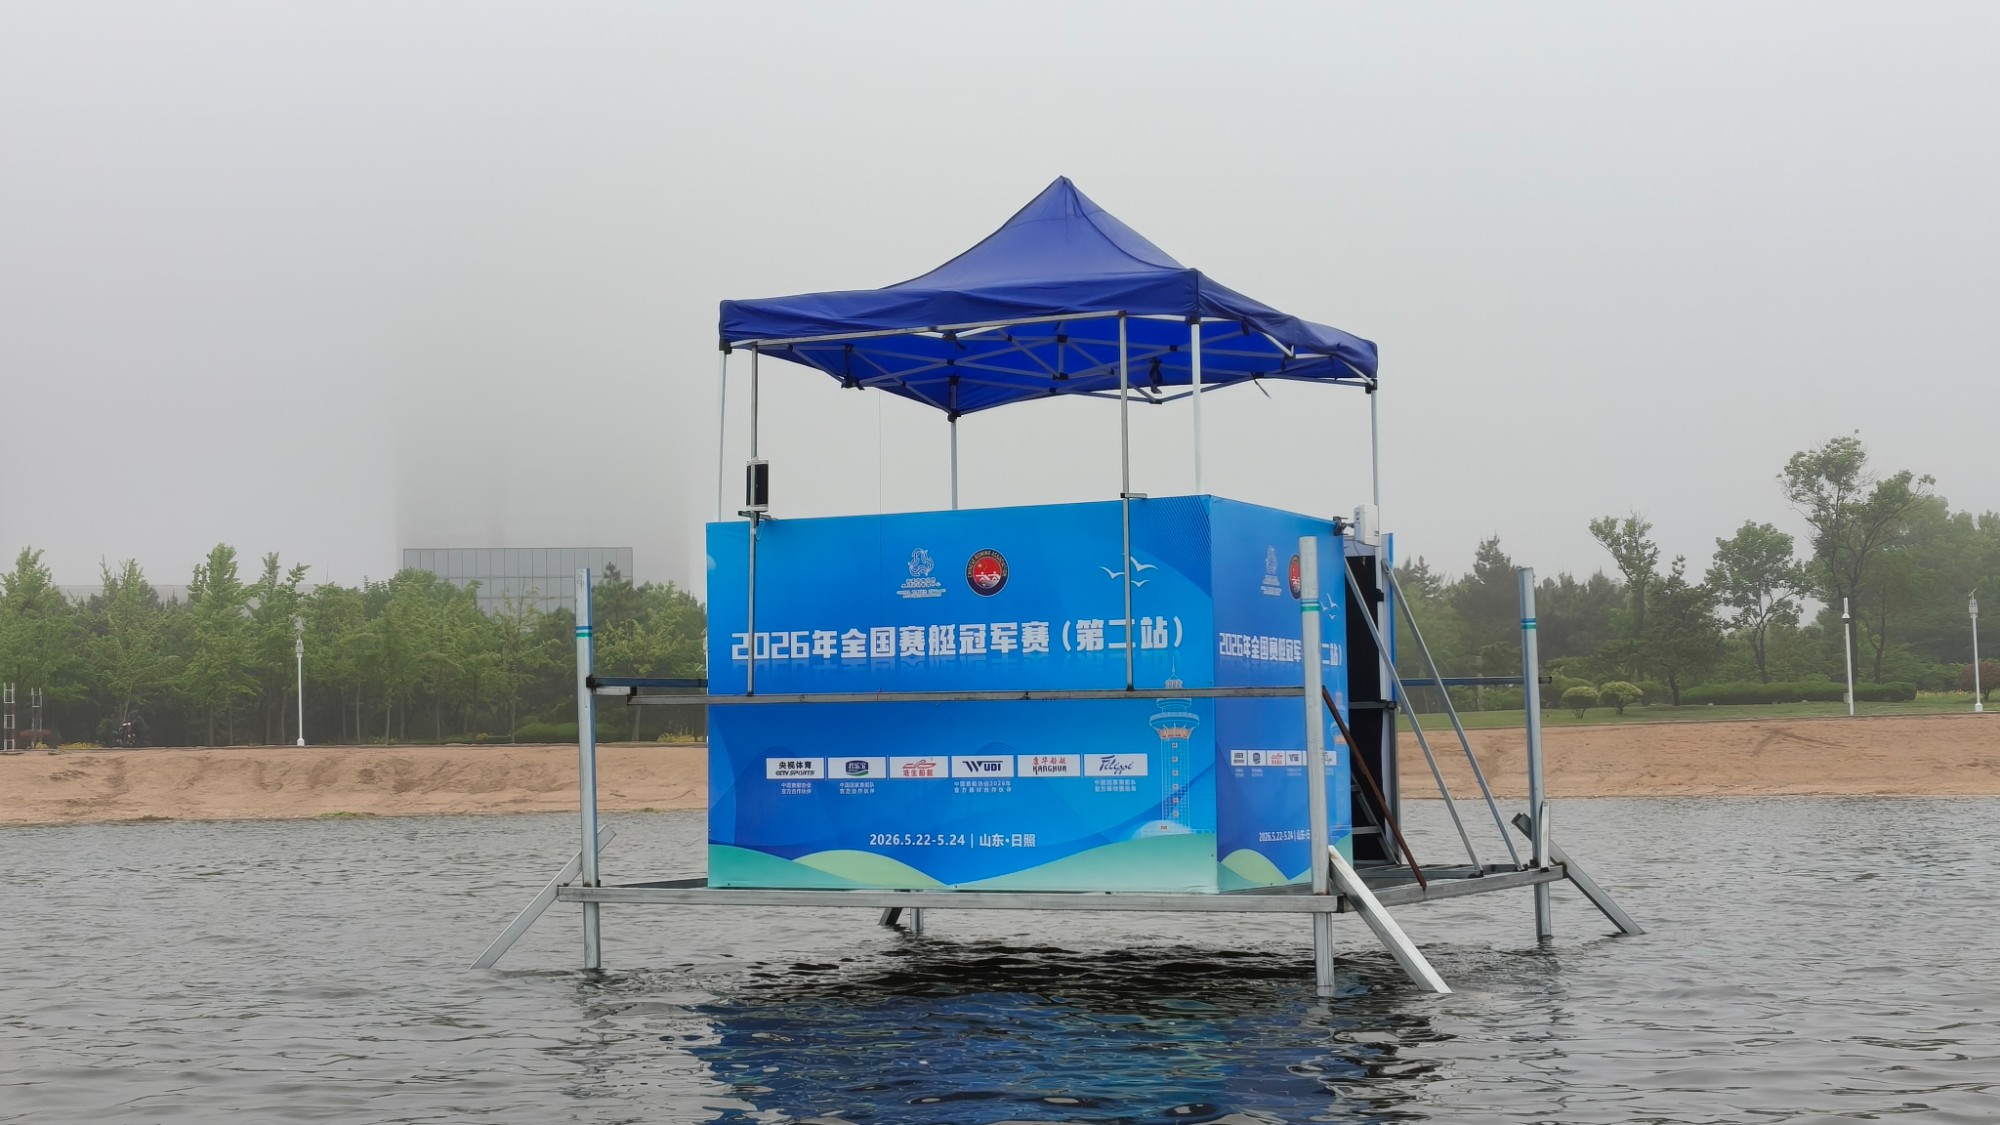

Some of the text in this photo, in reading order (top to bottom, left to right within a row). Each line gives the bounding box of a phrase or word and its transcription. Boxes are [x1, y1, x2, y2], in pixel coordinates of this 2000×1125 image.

[779, 761, 812, 770] 央视体育
[962, 760, 1003, 773] WUDI
[1032, 765, 1067, 775] KANGHUA
[869, 833, 1036, 848] 2026.5.22-5.24 山东·日照
